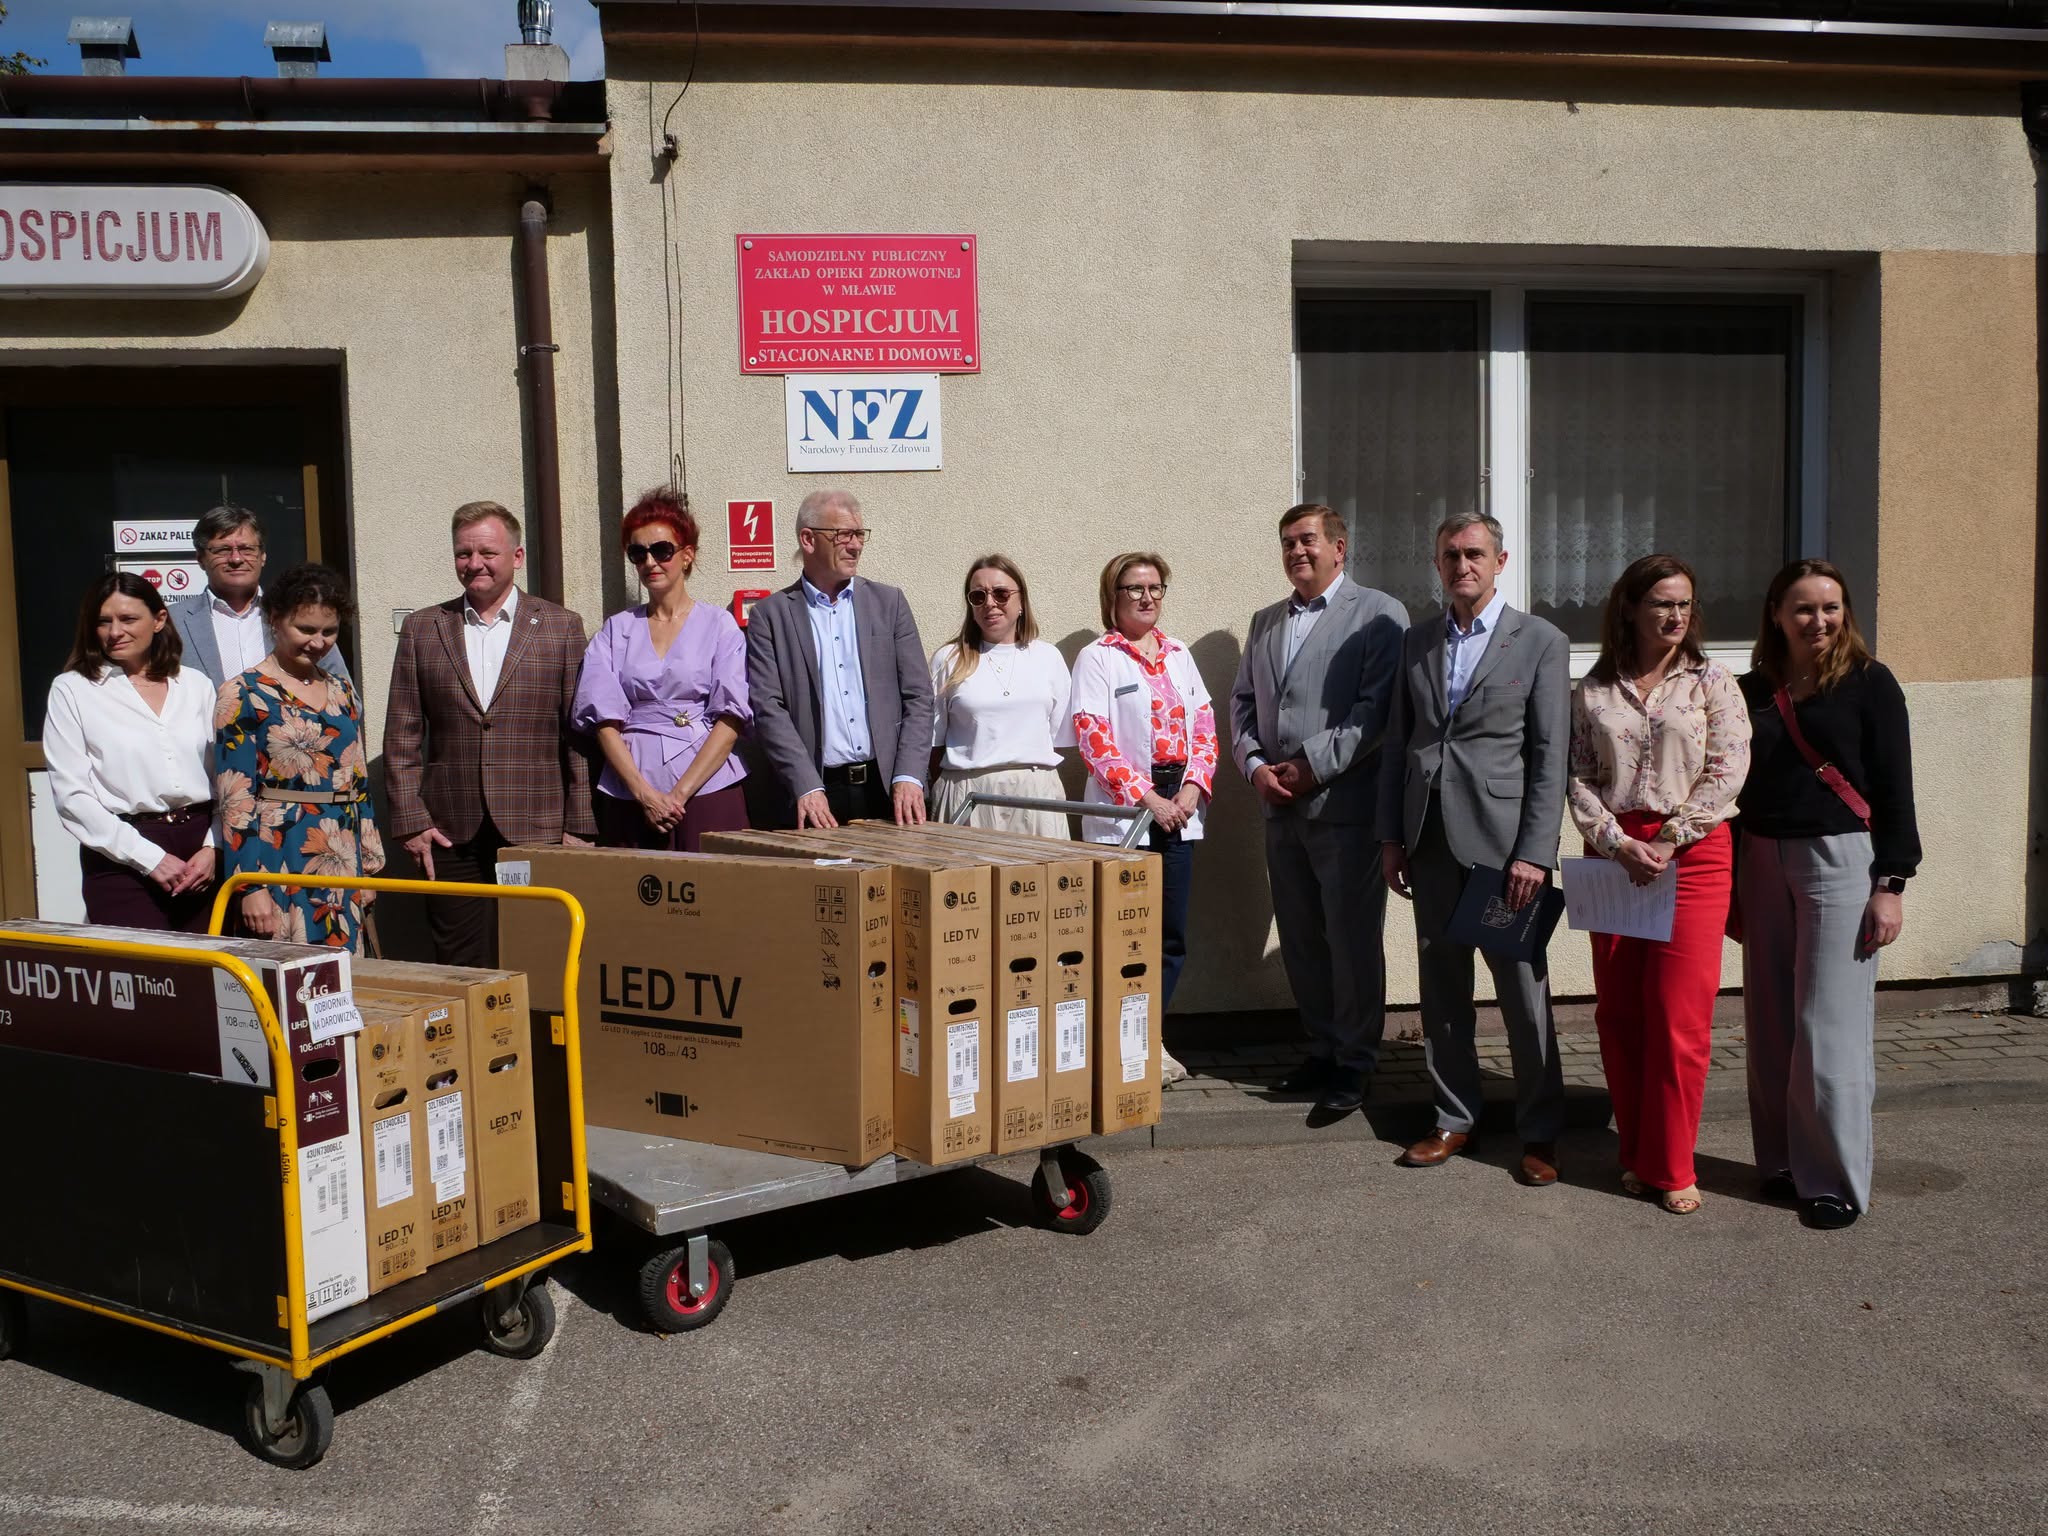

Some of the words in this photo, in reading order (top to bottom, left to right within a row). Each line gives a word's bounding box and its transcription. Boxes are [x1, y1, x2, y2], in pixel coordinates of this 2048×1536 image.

[768, 250, 866, 262] SAMODZIELNY
[872, 250, 947, 262] PUBLICZNY
[755, 268, 810, 279] ZAKŁAD
[816, 268, 864, 278] OPIEKI
[870, 267, 961, 278] ZDROWOTNEJ
[822, 285, 835, 296] W
[841, 284, 896, 296] MŁAWIE
[760, 308, 960, 334] HOSPICJUM
[758, 348, 874, 362] STACJONARNE
[878, 348, 884, 360] I
[888, 348, 963, 361] DOMOWE
[799, 389, 928, 441] NFZ
[800, 445, 846, 456] Narodowy
[849, 444, 888, 454] Fundusz
[891, 444, 930, 453] Zdrowia
[140, 532, 168, 540] ZAKAZ
[1070, 877, 1083, 888] LG
[1133, 870, 1146, 882] LG
[668, 882, 696, 904] LG
[1023, 881, 1036, 892] LG
[960, 892, 976, 904] LG
[667, 908, 682, 916] Life's
[684, 908, 700, 916] Good
[1006, 912, 1025, 926] LED
[1027, 910, 1040, 922] TV
[1054, 908, 1072, 920] LED
[1074, 905, 1087, 918] TV
[1118, 909, 1136, 921] LED
[1138, 906, 1150, 918] TV
[866, 917, 879, 932] LED
[880, 914, 888, 928] TV
[944, 930, 964, 943] LED
[966, 928, 980, 940] TV
[6, 959, 60, 1000] UHD
[64, 966, 102, 1005] TV
[114, 979, 132, 1002] AI
[134, 974, 176, 998] ThinQ
[312, 984, 328, 998] LG
[600, 963, 675, 1011] LED
[685, 972, 742, 1020] TV
[498, 993, 512, 1006] LG
[291, 1020, 308, 1030] UHD
[312, 1020, 320, 1030] NA
[439, 1023, 452, 1036] LG
[490, 1115, 509, 1130] LED
[510, 1109, 522, 1122] TV
[432, 1204, 451, 1220] LED
[453, 1198, 466, 1211] TV
[378, 1229, 399, 1246] LED
[401, 1222, 414, 1236] TV
